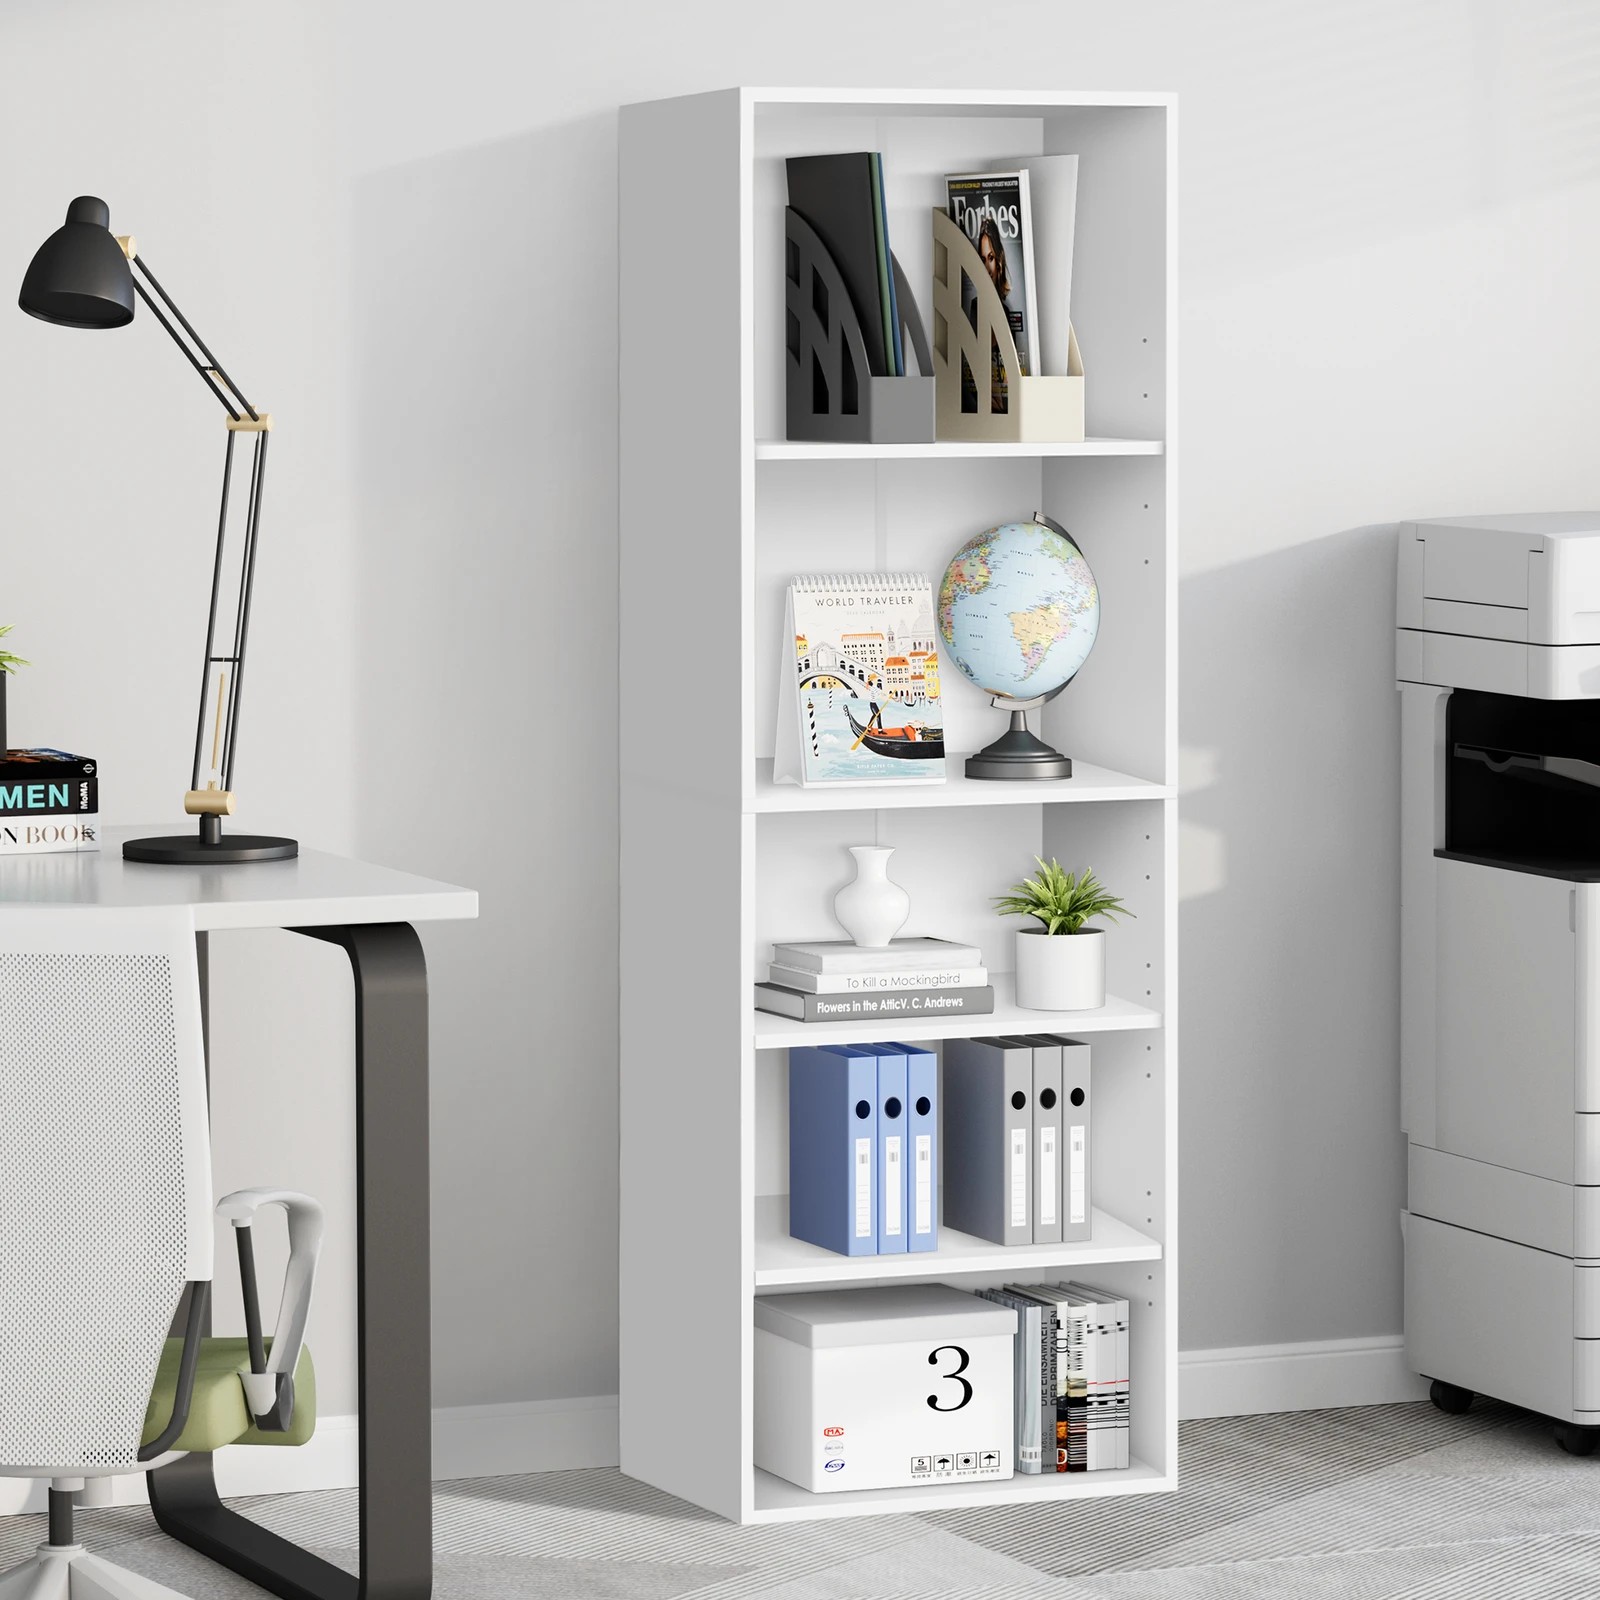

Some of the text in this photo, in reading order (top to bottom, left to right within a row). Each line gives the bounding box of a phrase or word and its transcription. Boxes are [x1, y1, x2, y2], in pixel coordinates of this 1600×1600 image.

[952, 194, 1019, 239] Forbes
[815, 596, 914, 607] WORLD TRAVELER
[0, 784, 69, 809] MEN
[80, 782, 88, 810] MoMA
[0, 824, 96, 845] N BOOK
[847, 973, 961, 988] To Kill a Mockingbird
[817, 1001, 851, 1014] Flowers
[852, 1000, 861, 1012] in
[863, 999, 878, 1012] the
[912, 997, 922, 1009] C.
[924, 996, 964, 1009] Andrews
[927, 1345, 973, 1412] 3
[917, 1458, 925, 1466] 5
